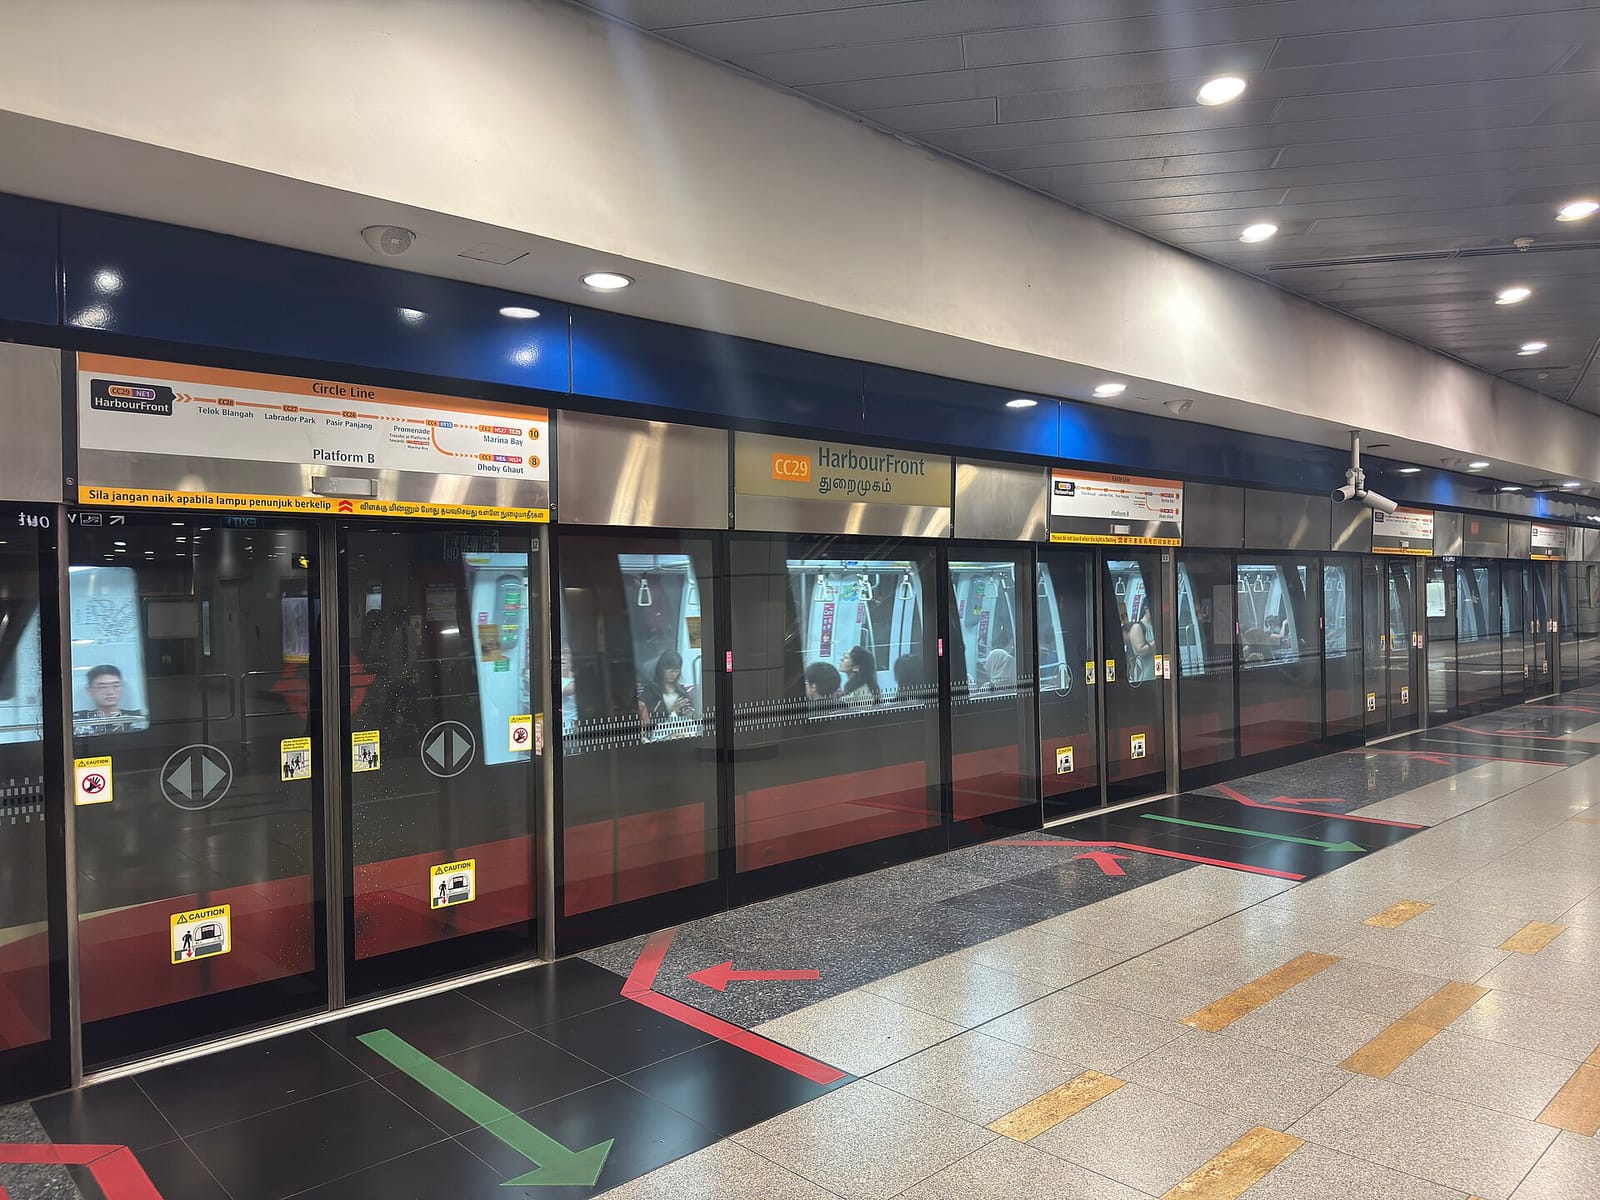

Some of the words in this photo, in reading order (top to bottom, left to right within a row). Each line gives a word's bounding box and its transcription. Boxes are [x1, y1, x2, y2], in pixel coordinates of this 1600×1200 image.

[112, 387, 130, 395] CC29
[136, 390, 150, 398] NE1
[312, 383, 346, 396] Circle
[350, 387, 375, 399] Line
[95, 397, 169, 412] HarbourFront
[218, 398, 234, 406] CC28
[198, 406, 220, 415] Telok
[222, 409, 254, 419] Blangah
[264, 413, 297, 422] Labrador
[300, 416, 316, 424] Park
[326, 418, 343, 426] Pasir
[345, 420, 373, 430] Panjang
[393, 425, 430, 434] Promenade
[530, 430, 539, 438] 10
[483, 435, 509, 444] Marina
[510, 438, 523, 447] Bay
[313, 449, 363, 463] Platform
[368, 453, 375, 463] B
[531, 457, 537, 466] 8
[818, 447, 925, 476] HarbourFront
[477, 463, 500, 474] Dhoby
[502, 465, 524, 474] Ghaut
[775, 458, 808, 477] CC29
[819, 476, 892, 496] துறைமுகம்
[89, 489, 109, 499] Sila
[111, 491, 149, 503] jangan
[152, 493, 174, 503] naik
[177, 495, 214, 505] apabila
[216, 496, 246, 507] lampu
[249, 499, 293, 509] penunjuk
[295, 500, 331, 510] berkelip
[443, 862, 472, 872] CAUTION
[188, 908, 225, 921] CAUTION
